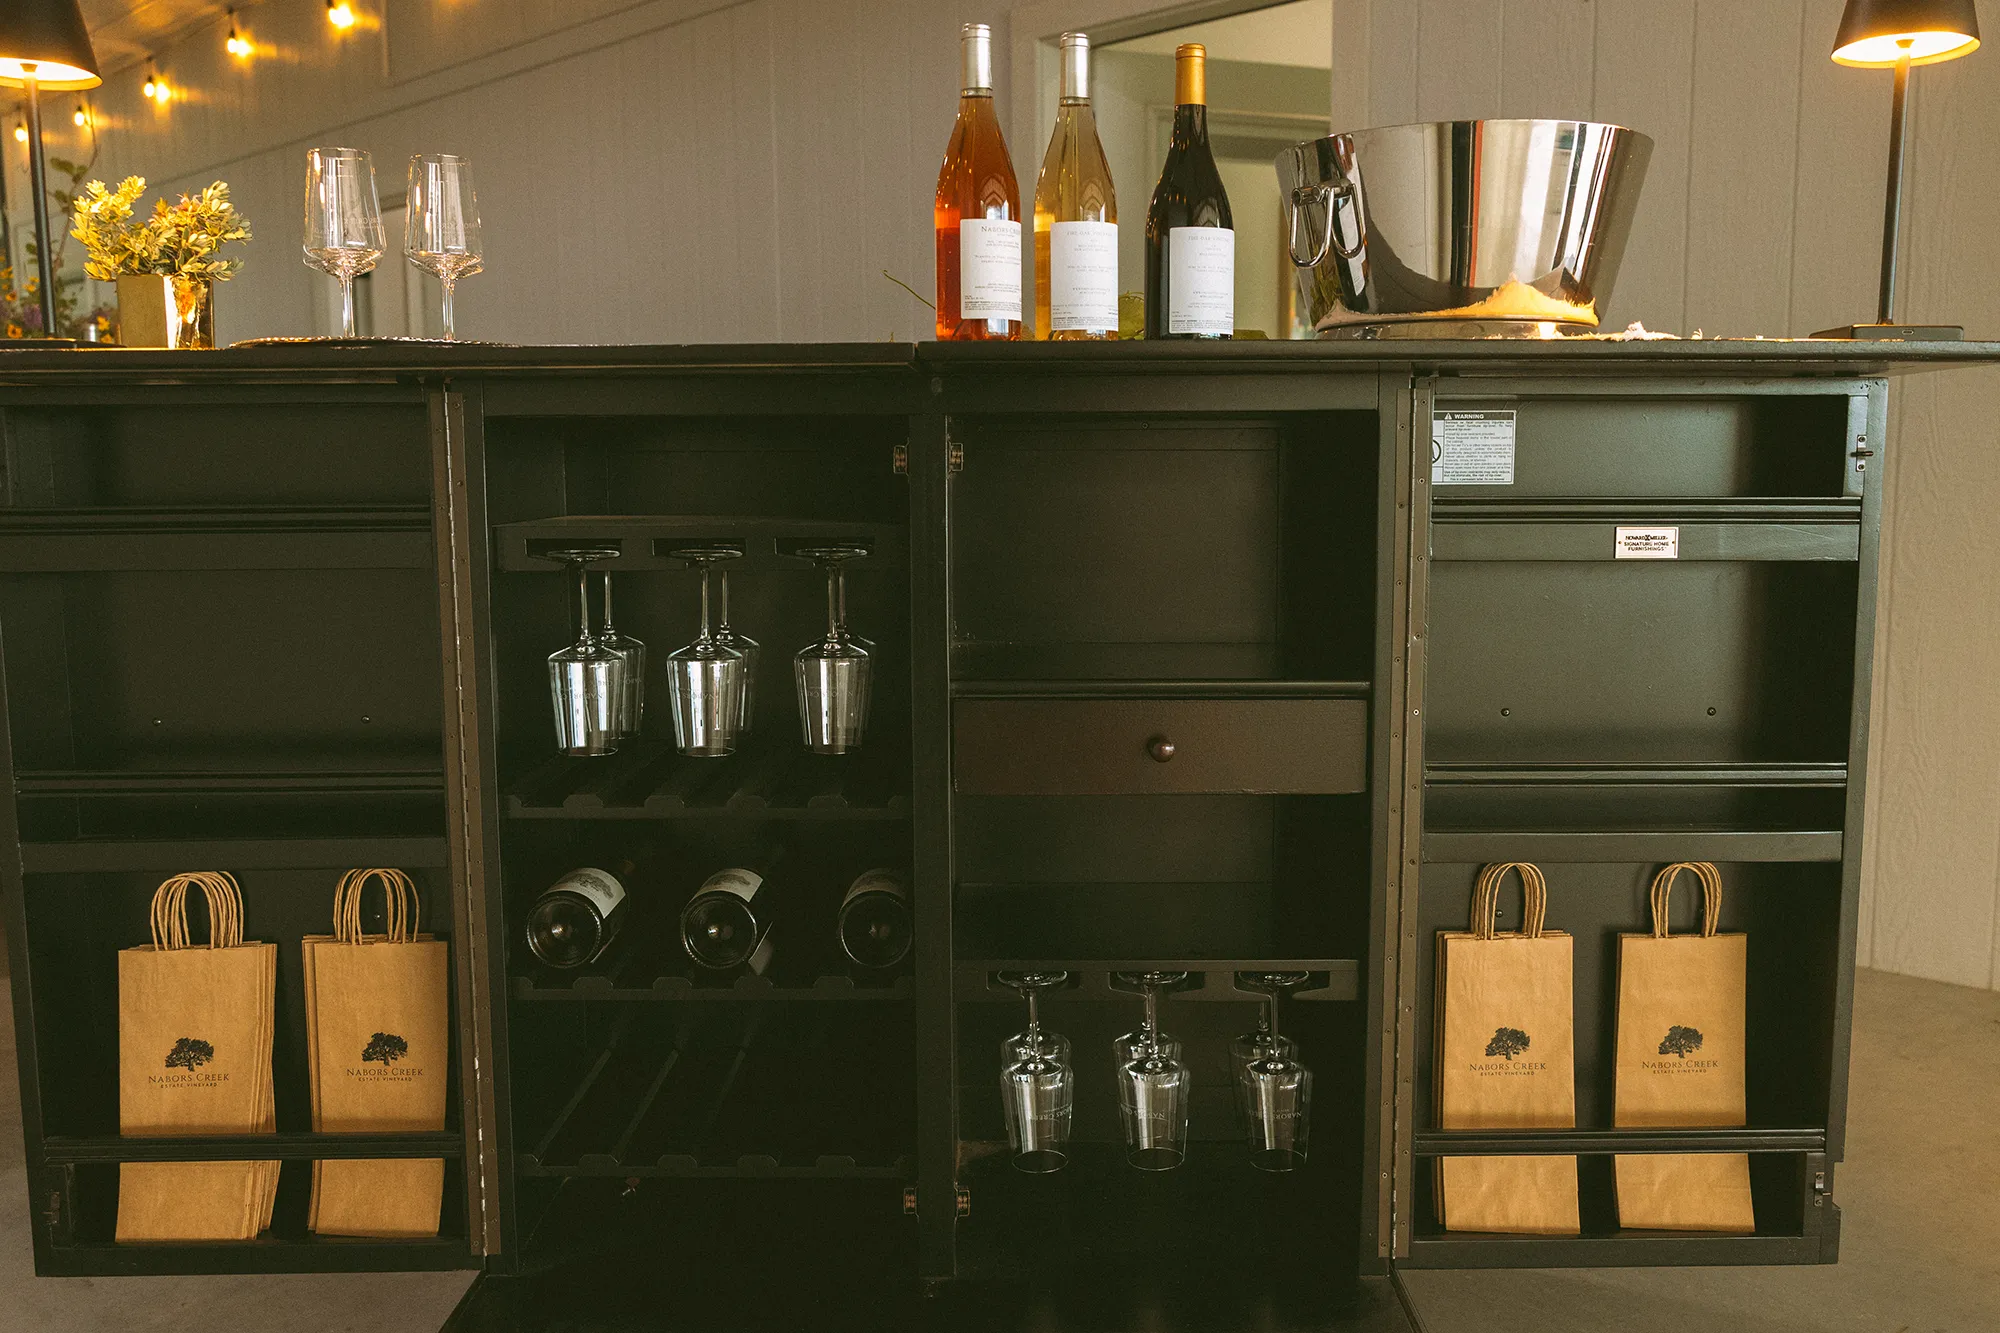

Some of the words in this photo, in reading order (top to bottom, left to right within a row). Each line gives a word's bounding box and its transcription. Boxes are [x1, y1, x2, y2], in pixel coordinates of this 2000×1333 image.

[981, 225, 1009, 233] NABORS
[1469, 1062, 1510, 1071] NABORS
[1513, 1062, 1547, 1070] CREEK
[1641, 1061, 1683, 1069] NABORS
[1686, 1060, 1719, 1068] CREEK
[346, 1067, 388, 1076] NABORS
[391, 1067, 423, 1076] CREEK
[148, 1074, 192, 1084] NABORS
[196, 1073, 230, 1081] CREEK
